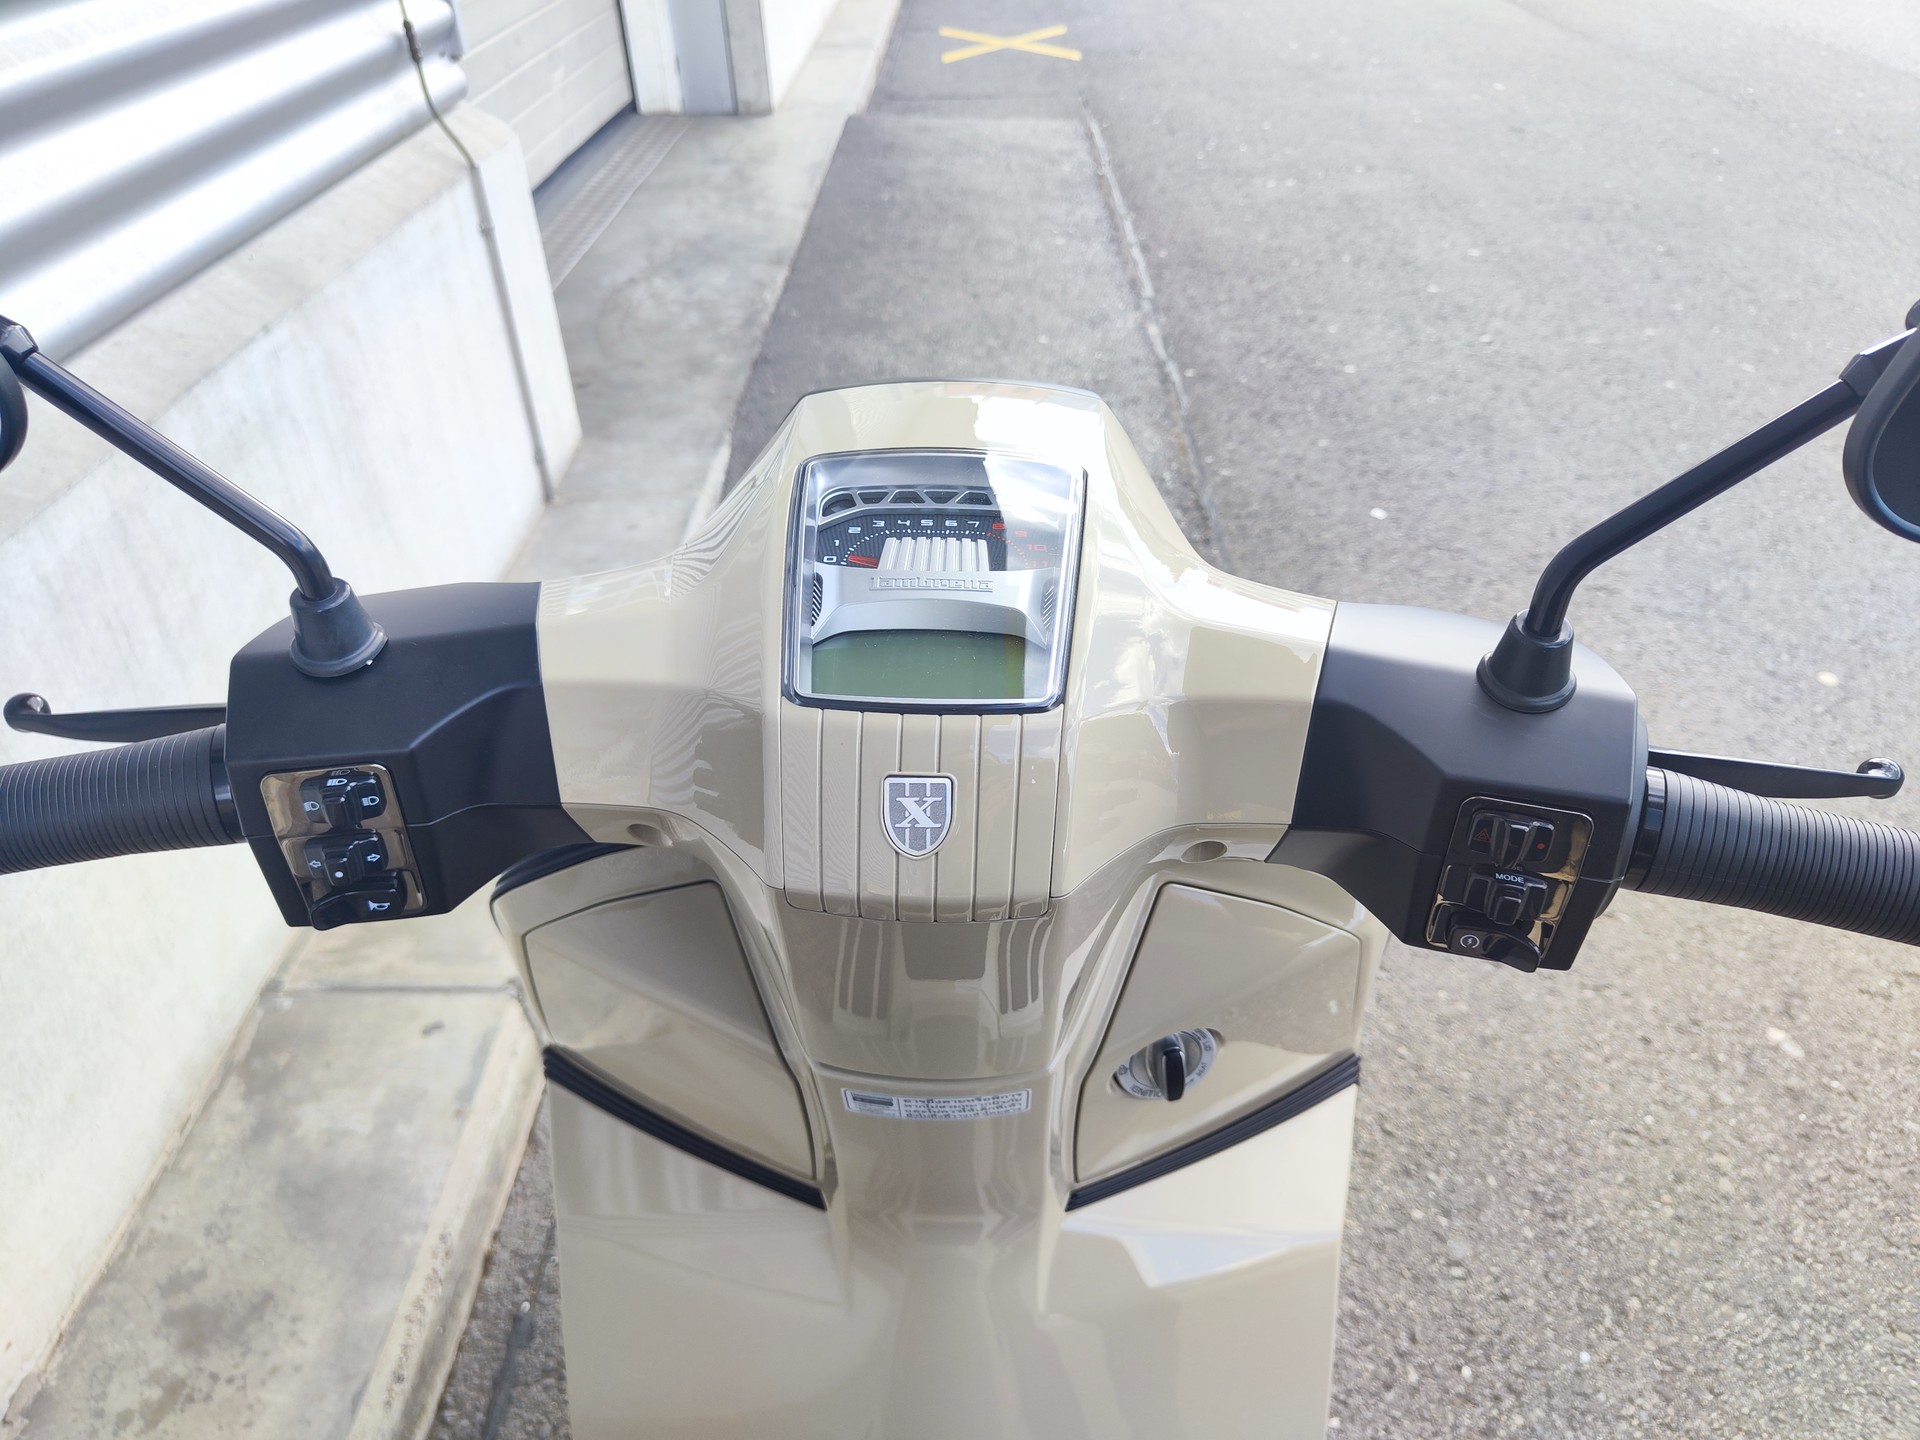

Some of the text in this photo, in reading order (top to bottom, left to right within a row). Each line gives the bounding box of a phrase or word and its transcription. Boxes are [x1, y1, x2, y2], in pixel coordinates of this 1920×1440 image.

[920, 519, 934, 527] 5
[823, 555, 837, 563] 0
[894, 797, 942, 828] X
[1495, 873, 1524, 884] MODE
